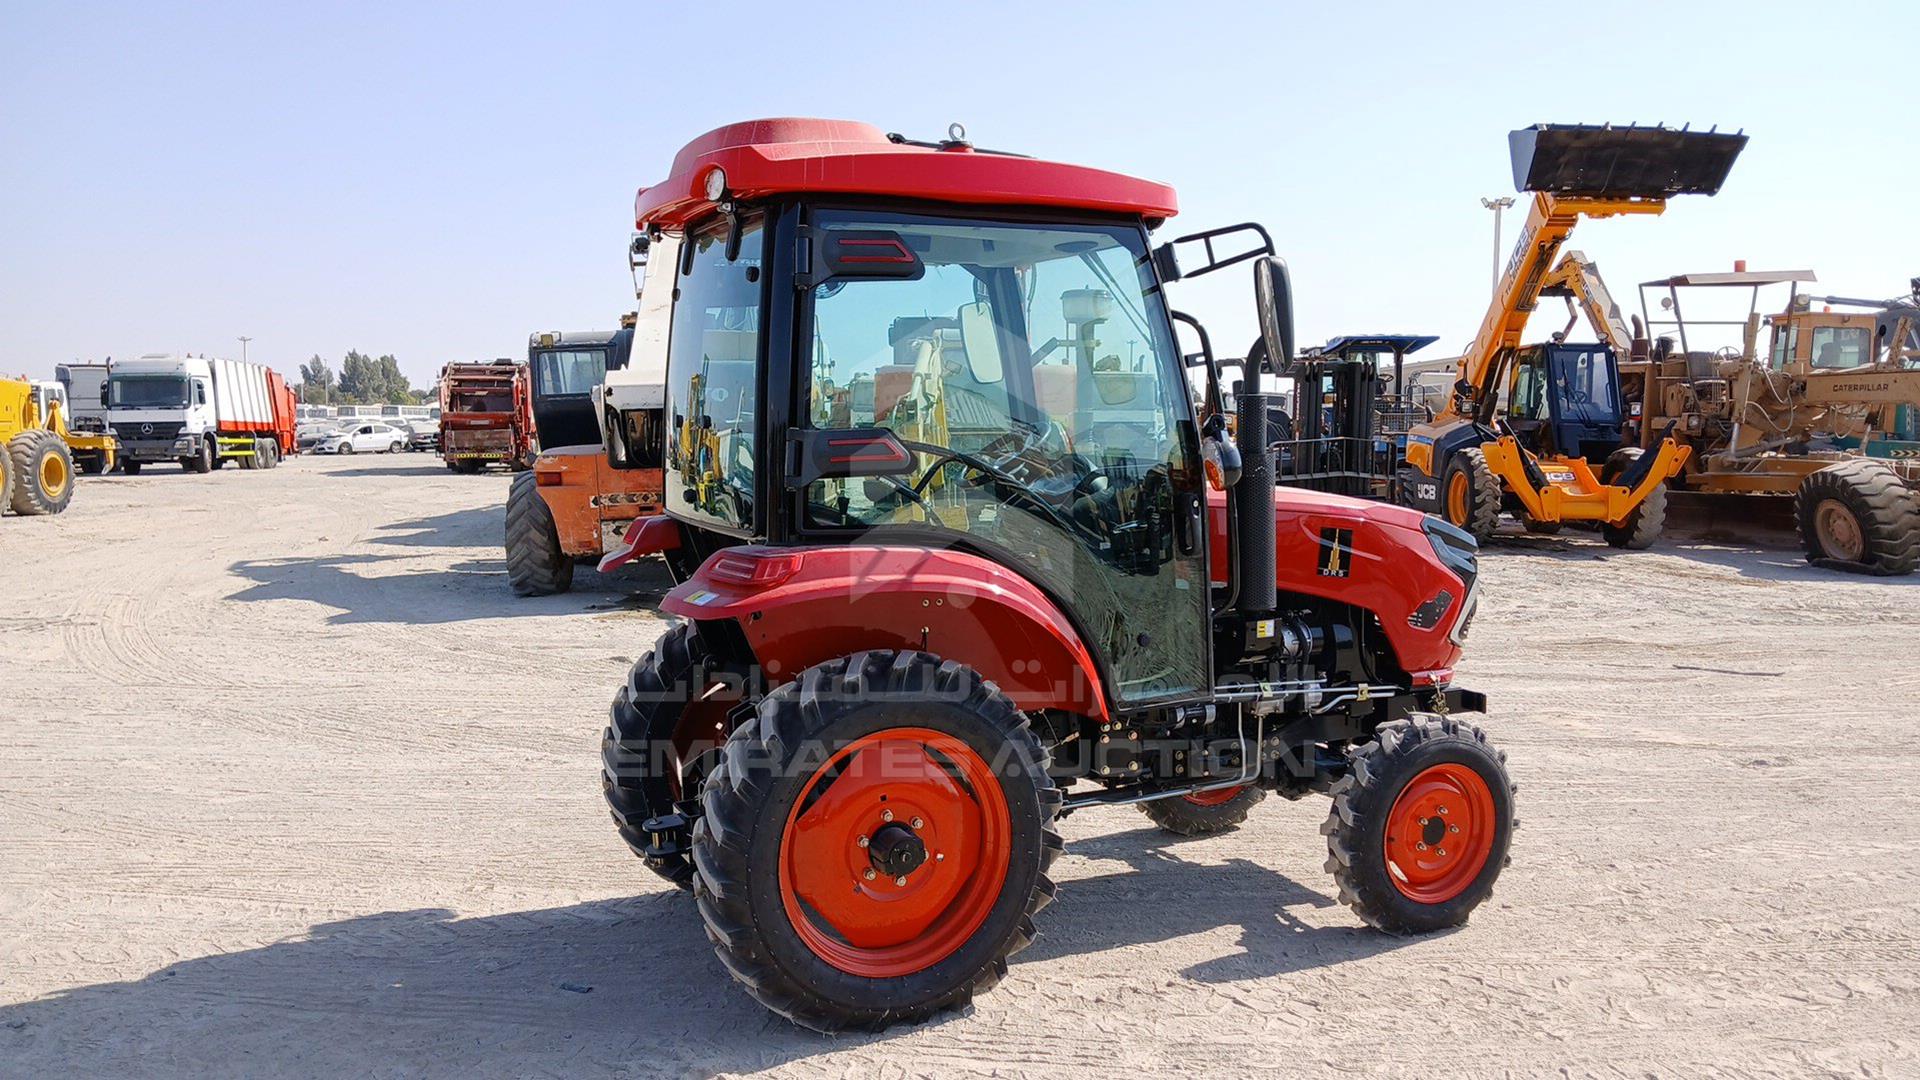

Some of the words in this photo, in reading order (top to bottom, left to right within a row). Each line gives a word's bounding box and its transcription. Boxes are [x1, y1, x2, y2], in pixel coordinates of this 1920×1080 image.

[1508, 224, 1529, 275] JCB
[1832, 383, 1889, 393] CATERPILLAR
[1417, 483, 1436, 500] JCB
[1322, 568, 1344, 577] DRS
